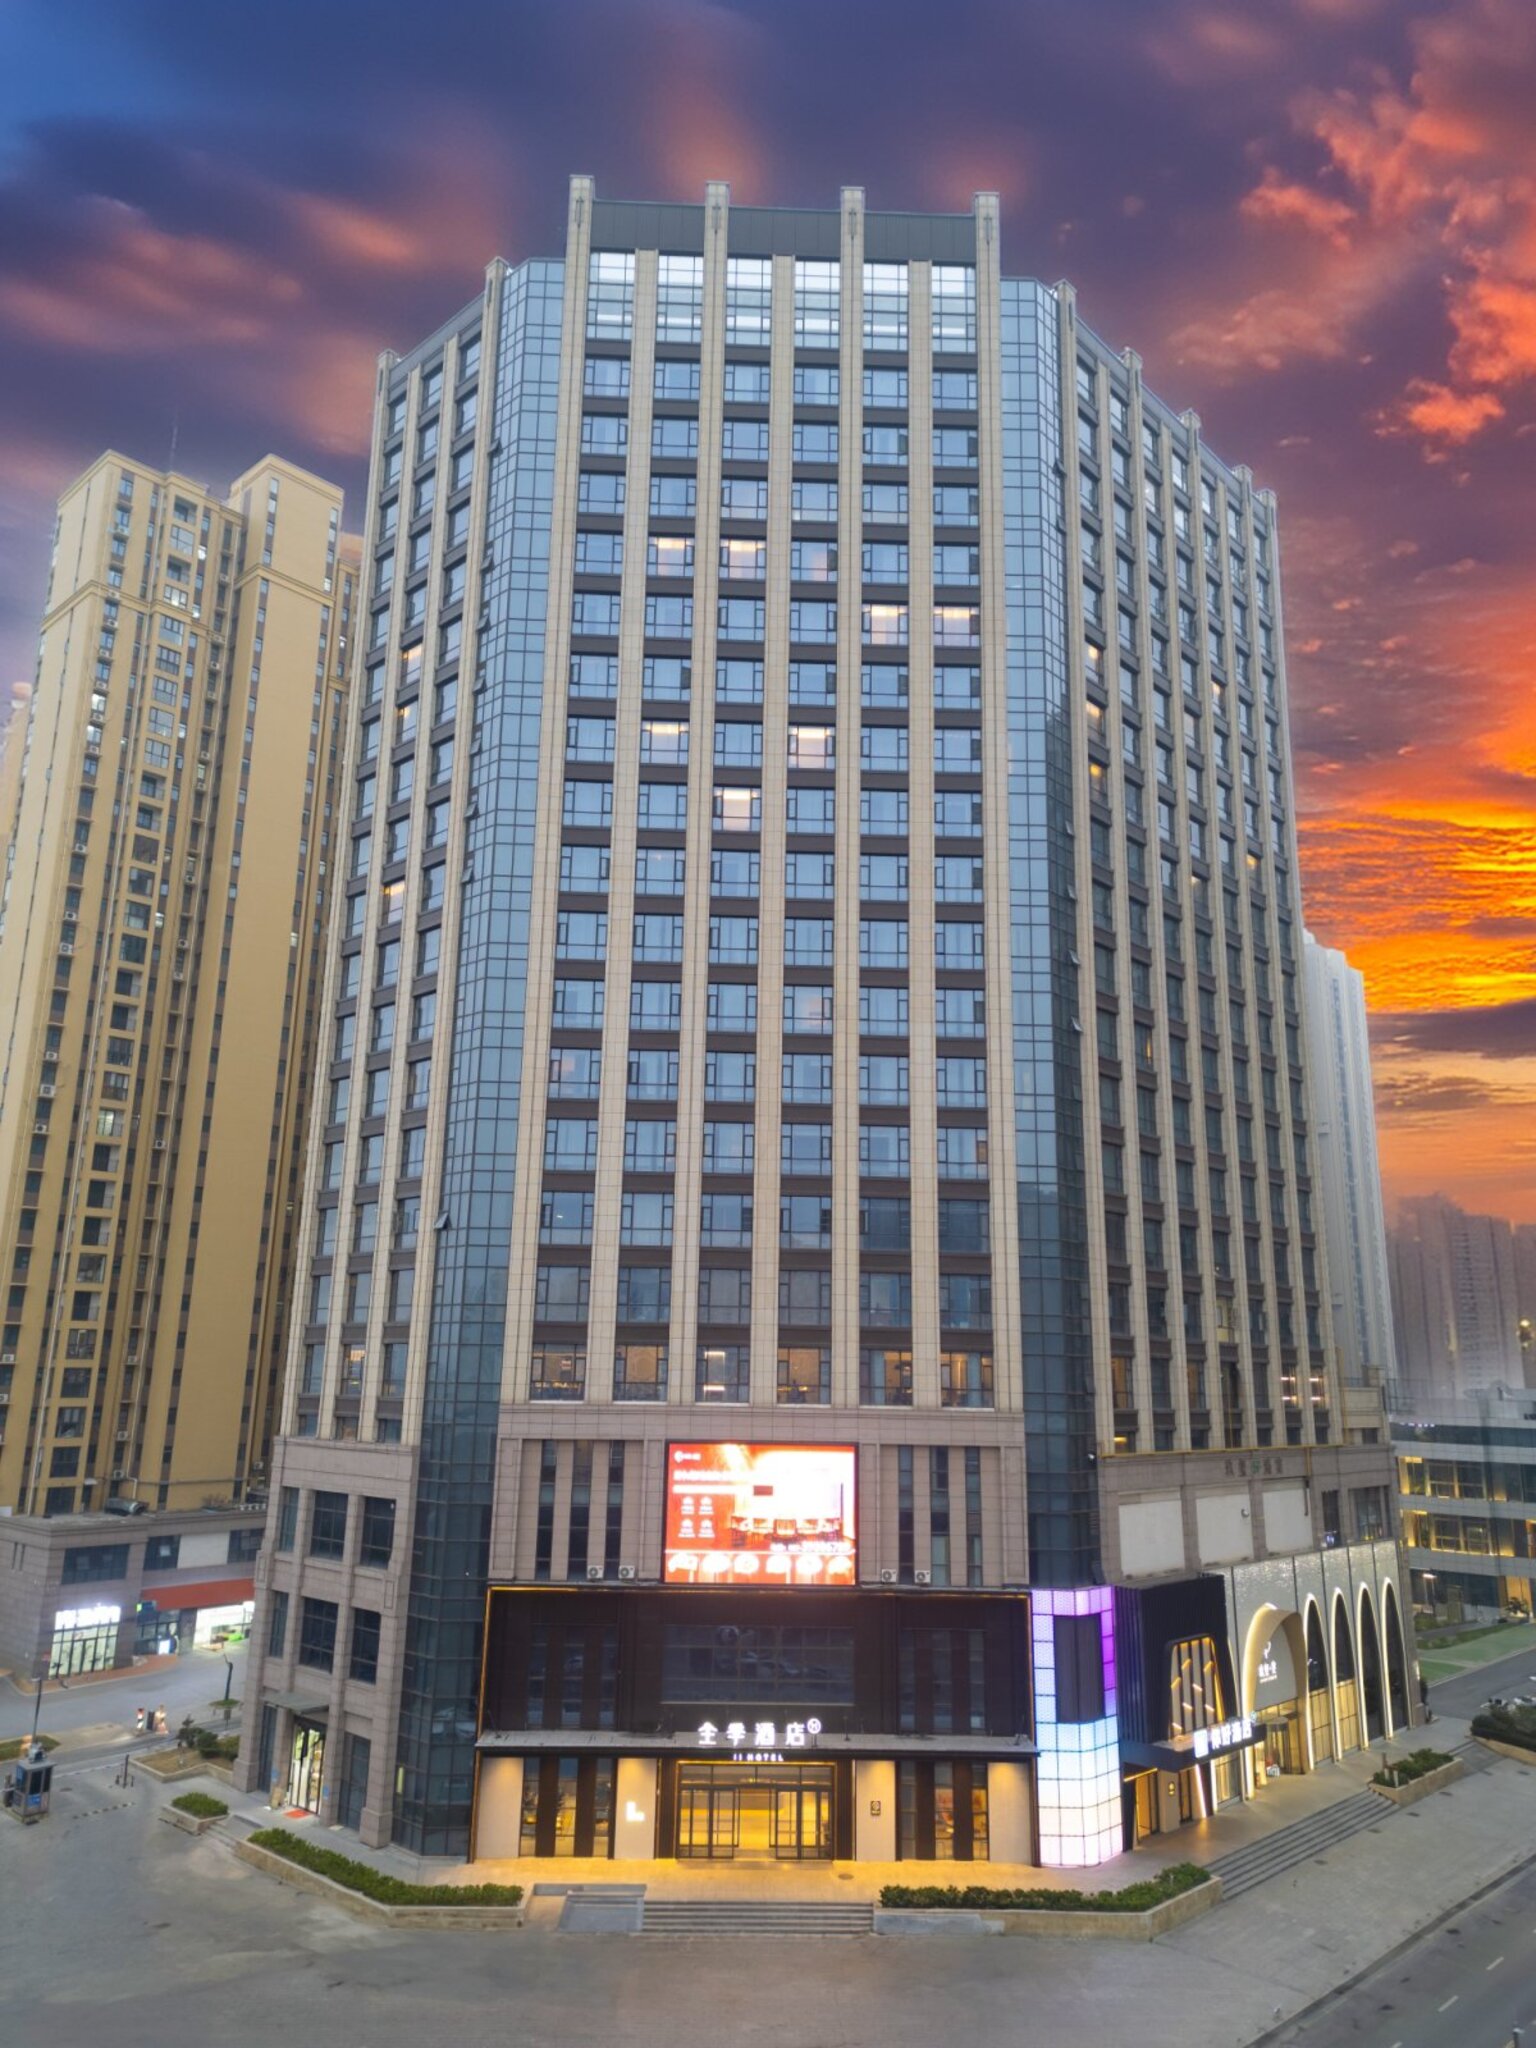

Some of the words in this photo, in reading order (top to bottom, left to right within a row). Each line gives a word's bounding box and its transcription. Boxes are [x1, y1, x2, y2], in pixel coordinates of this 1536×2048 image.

[697, 1721, 806, 1747] 全季酒店
[746, 1753, 784, 1762] HOTEL
